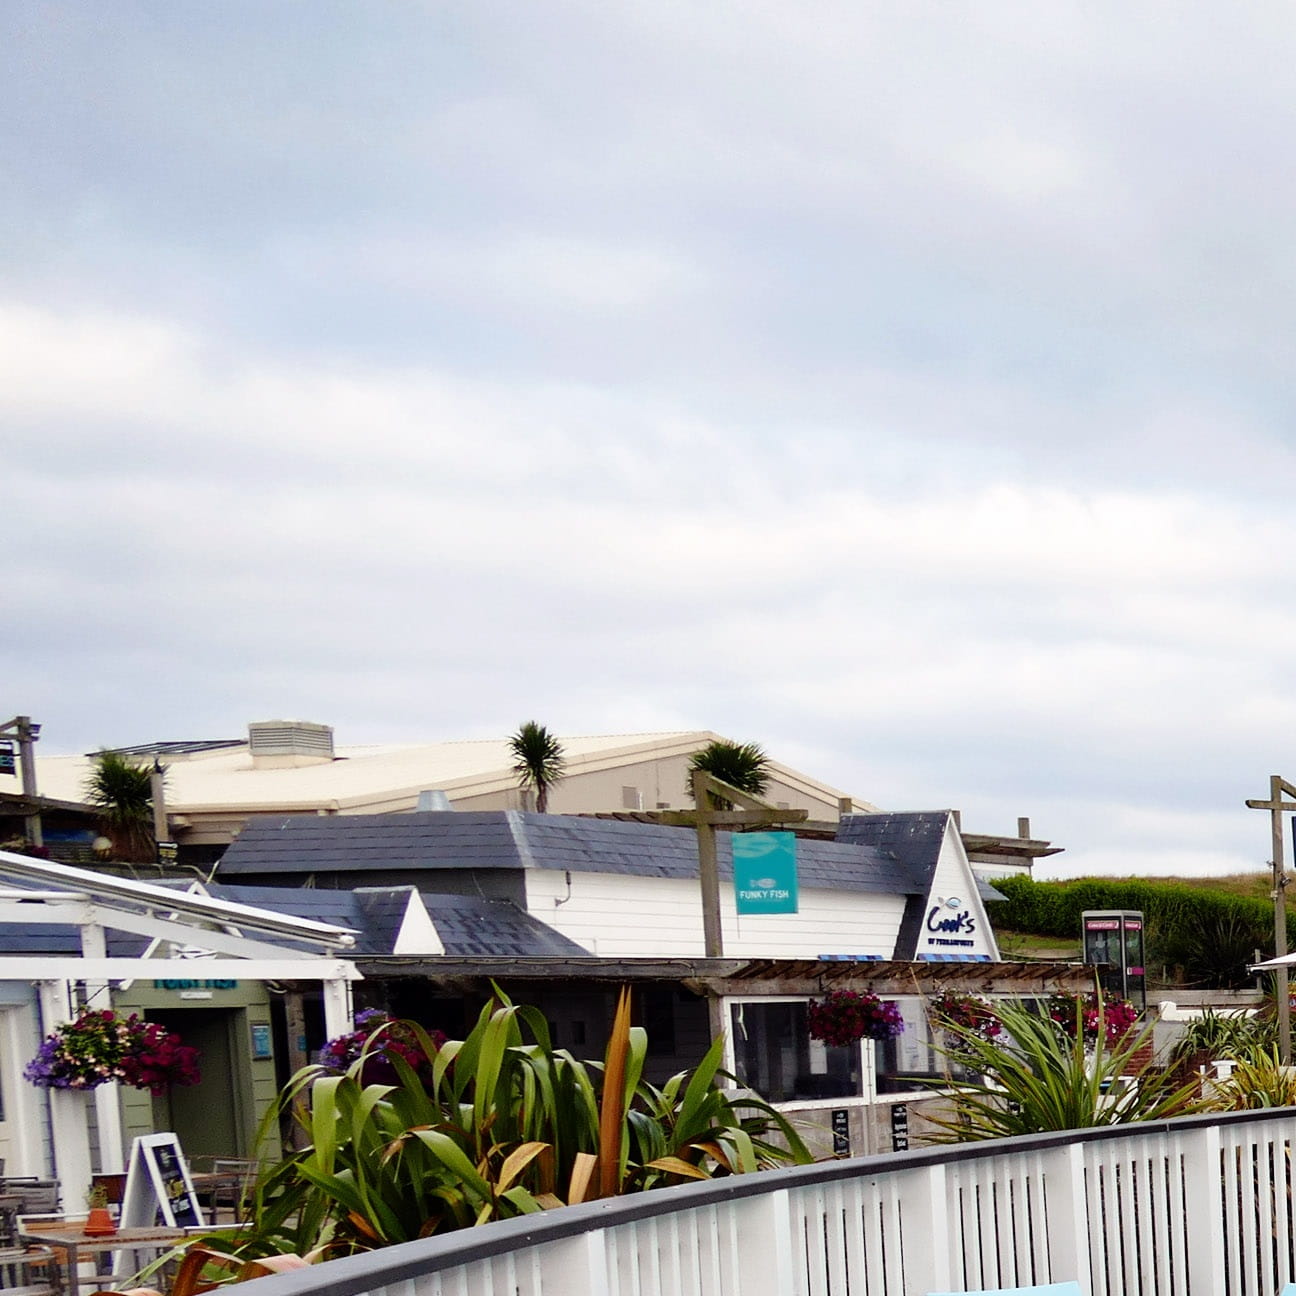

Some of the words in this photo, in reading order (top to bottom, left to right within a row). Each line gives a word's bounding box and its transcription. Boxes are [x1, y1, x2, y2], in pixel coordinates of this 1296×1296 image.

[740, 890, 768, 899] FUNKY
[769, 890, 789, 899] FISH
[927, 906, 975, 933] Cook's
